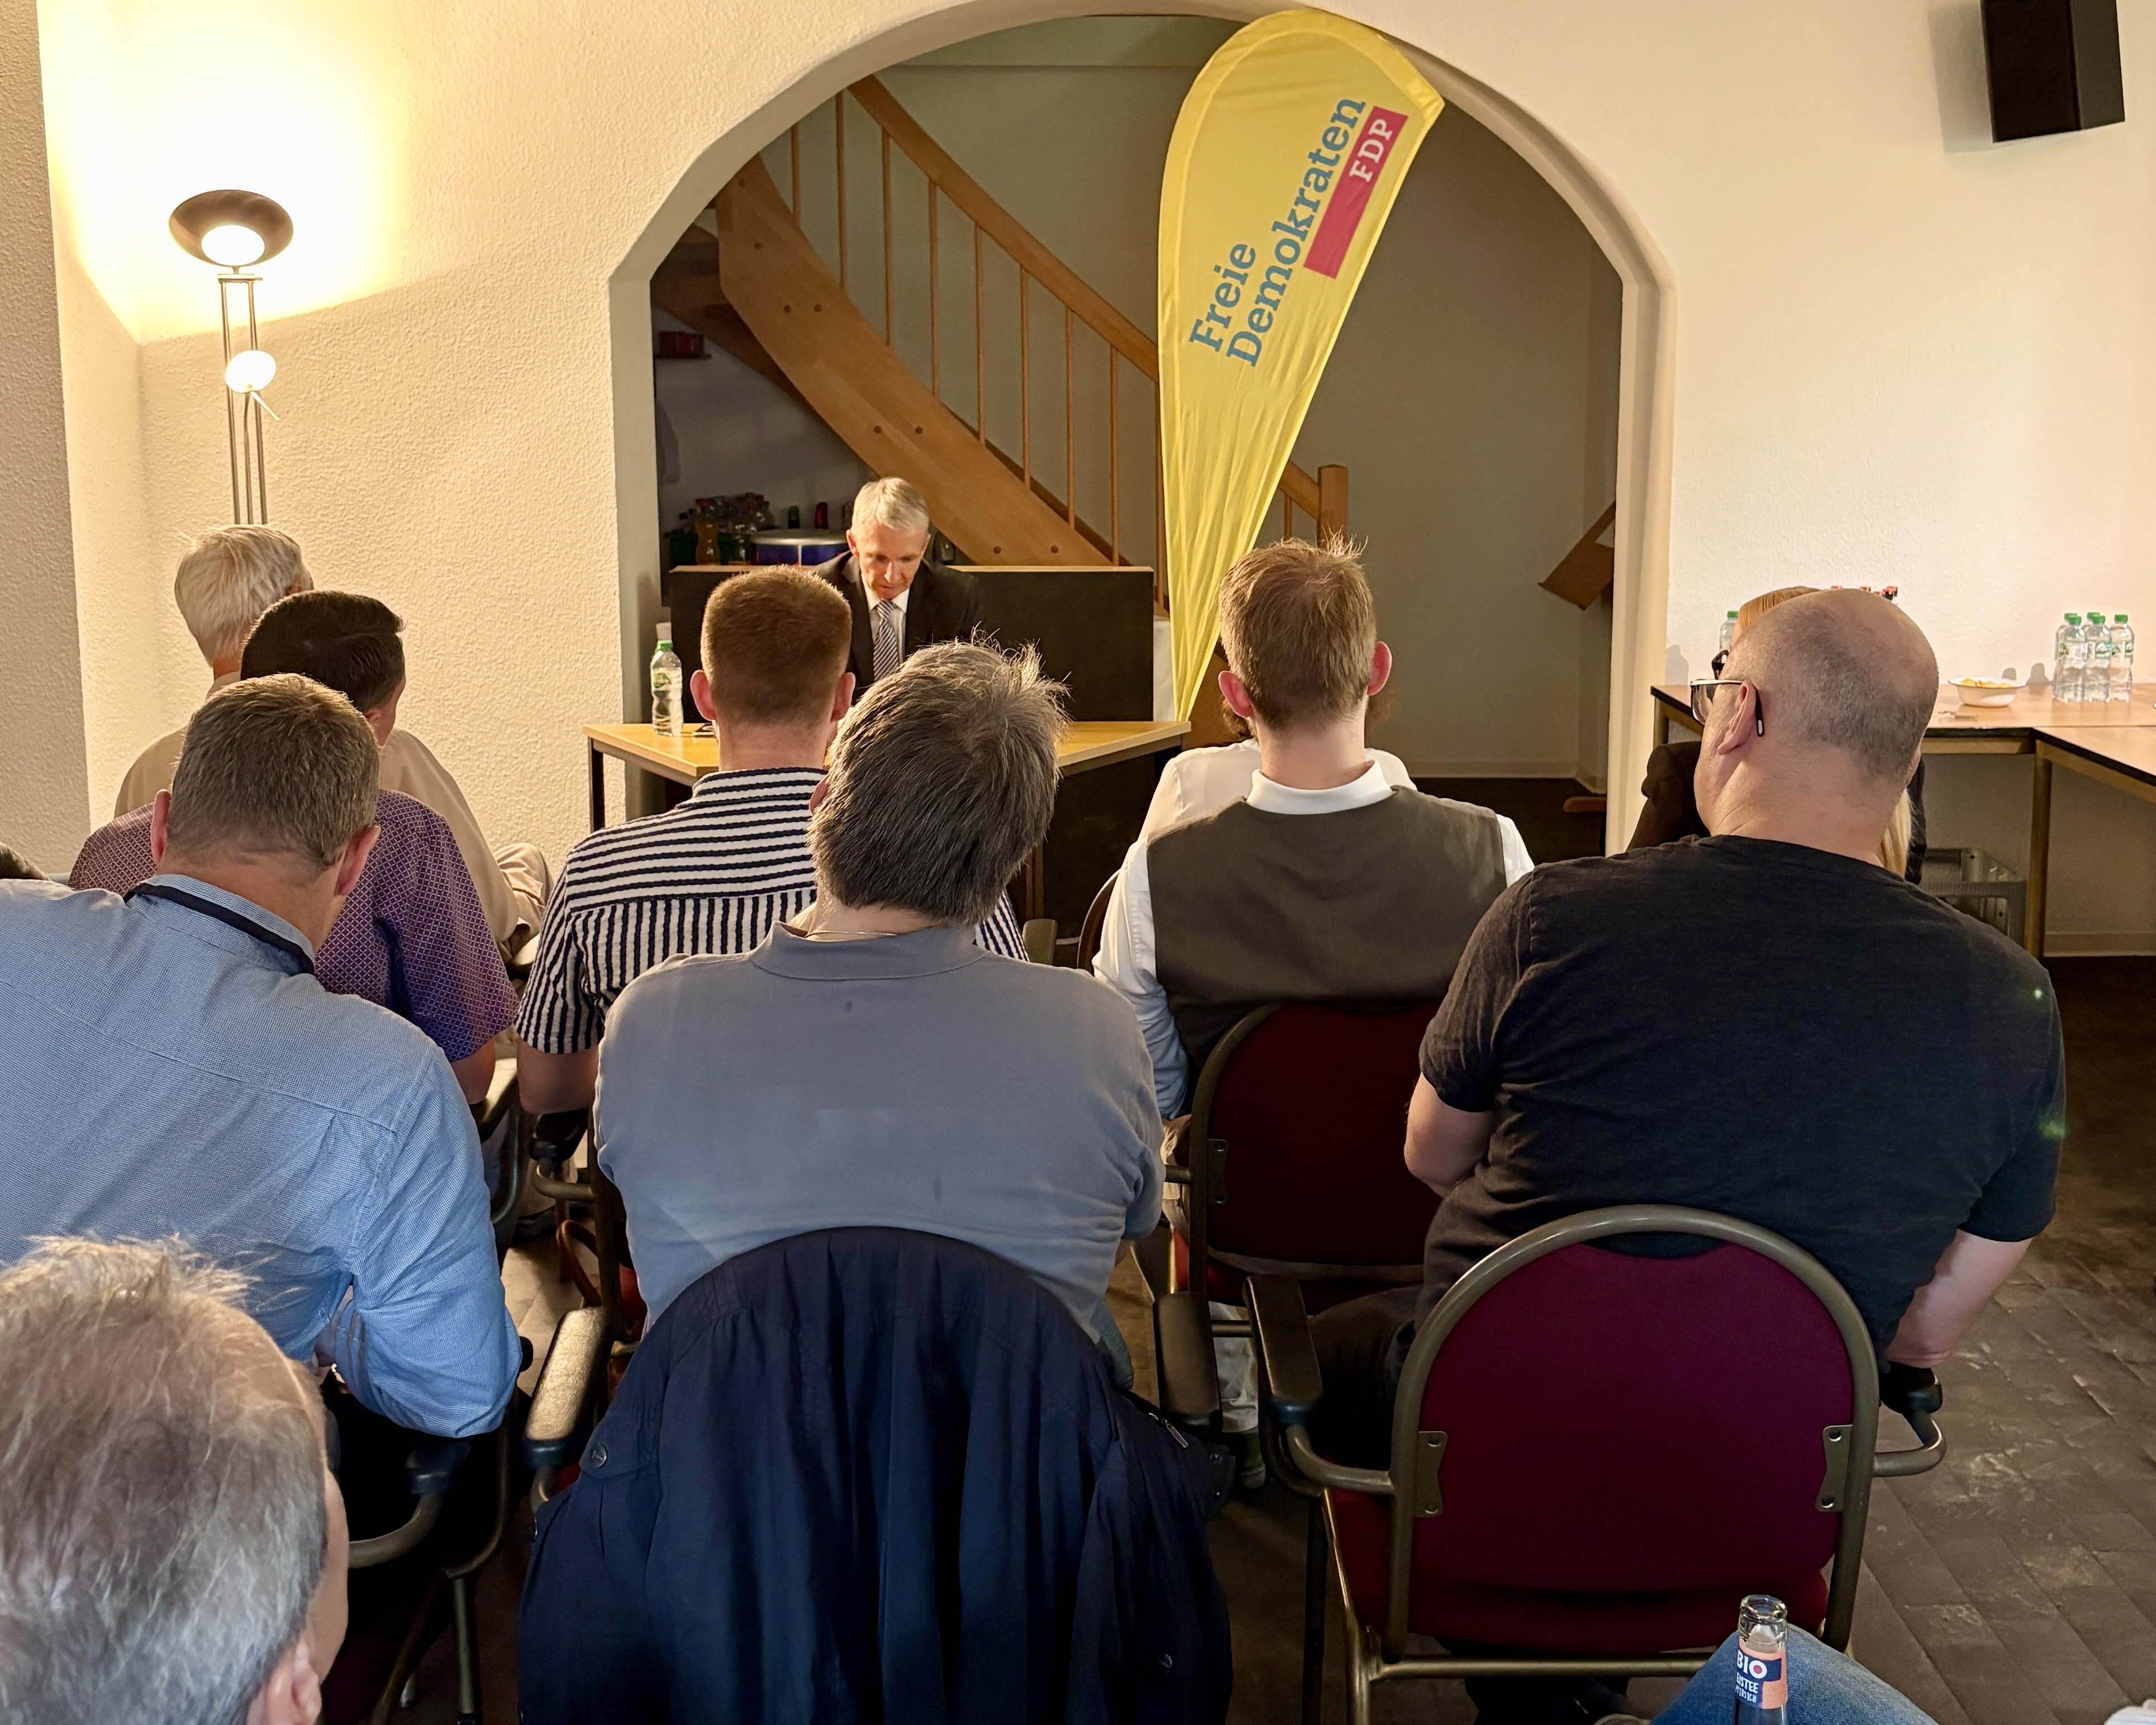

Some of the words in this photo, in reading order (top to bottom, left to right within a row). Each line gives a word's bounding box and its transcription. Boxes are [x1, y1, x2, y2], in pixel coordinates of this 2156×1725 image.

[1349, 118, 1393, 182] FDP
[1226, 98, 1366, 367] Demokraten
[1189, 243, 1256, 352] Freie
[1737, 1650, 1767, 1679] BIO
